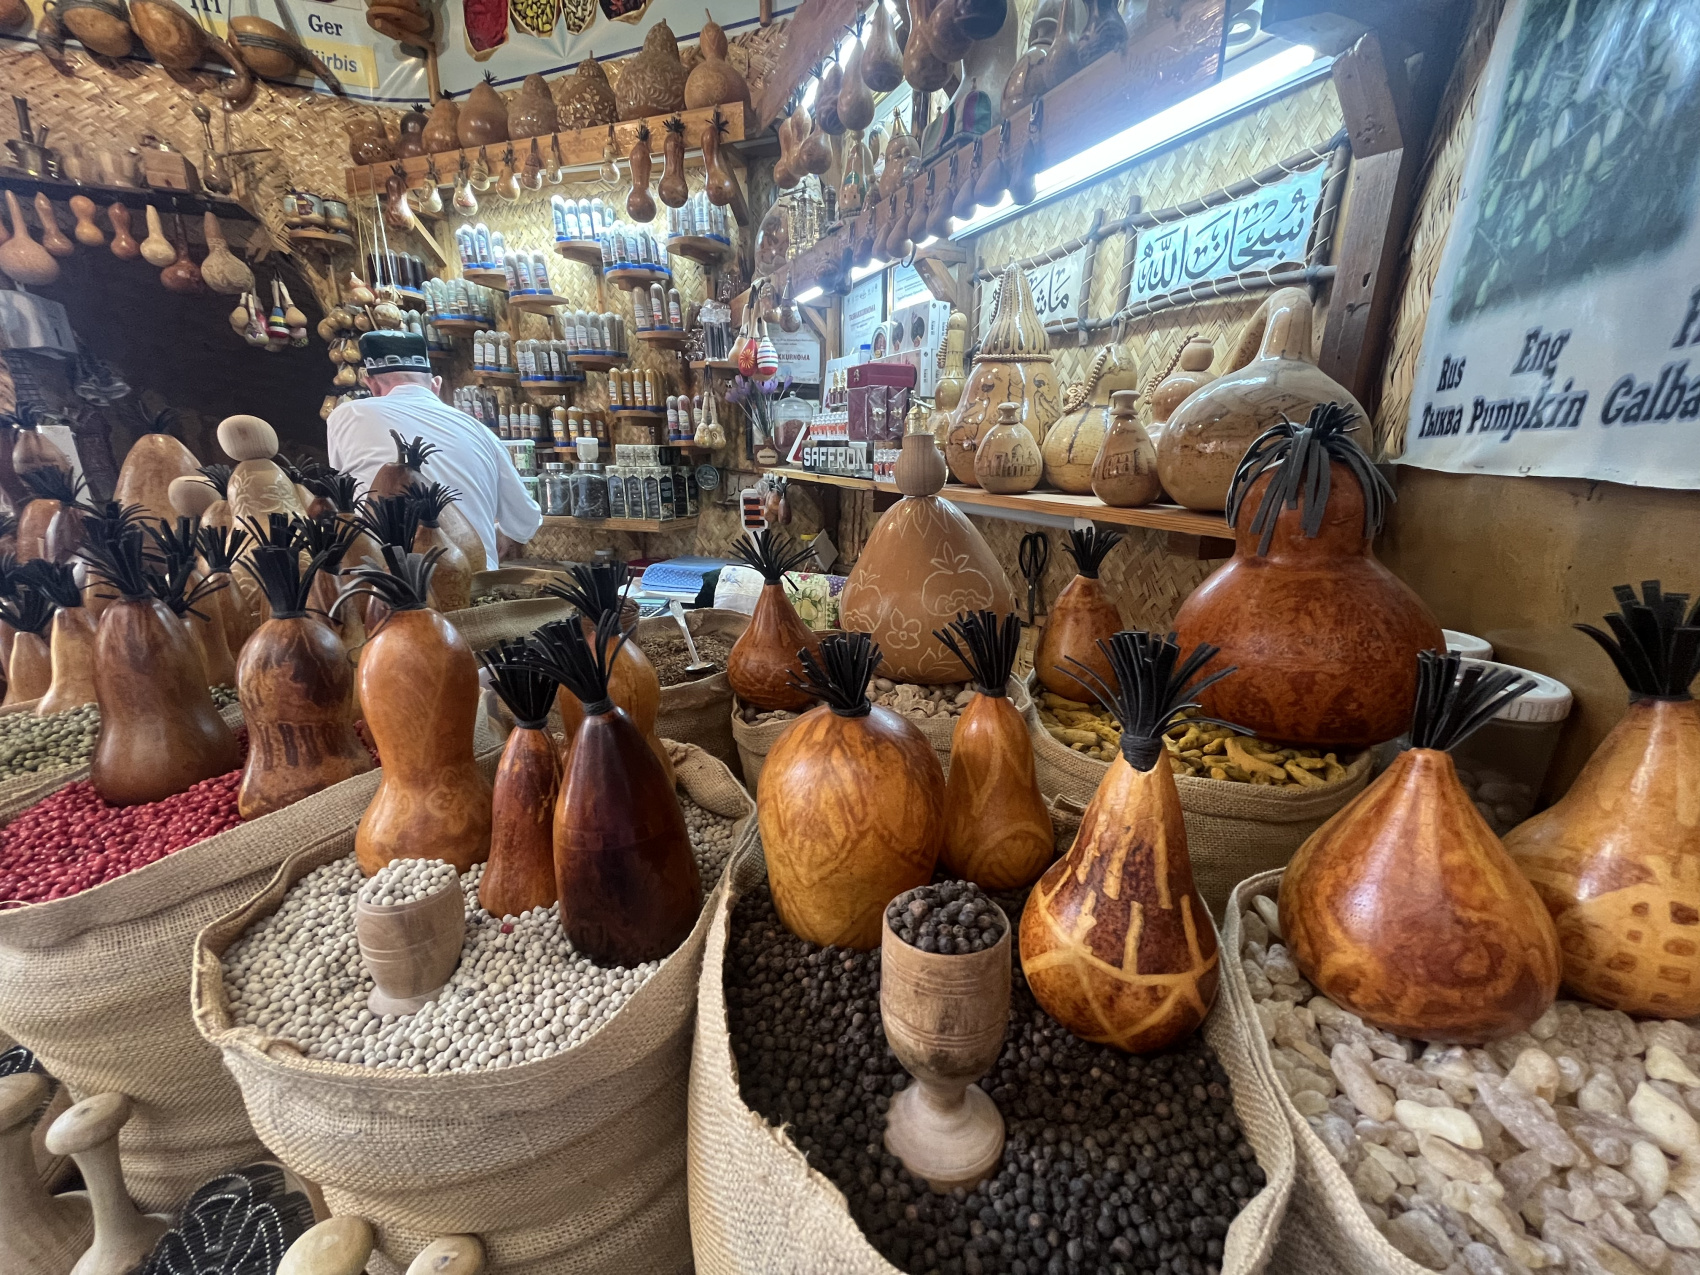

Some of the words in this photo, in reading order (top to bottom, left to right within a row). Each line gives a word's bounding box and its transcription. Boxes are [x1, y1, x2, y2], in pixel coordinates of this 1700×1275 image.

[308, 14, 343, 36] Ger
[311, 50, 357, 73] ürbis
[1437, 355, 1466, 392] Rus
[1511, 326, 1572, 378] Eng
[1418, 403, 1463, 438] Тыква
[1467, 378, 1588, 442] Pumpkin
[803, 447, 867, 470] SAFFRON
